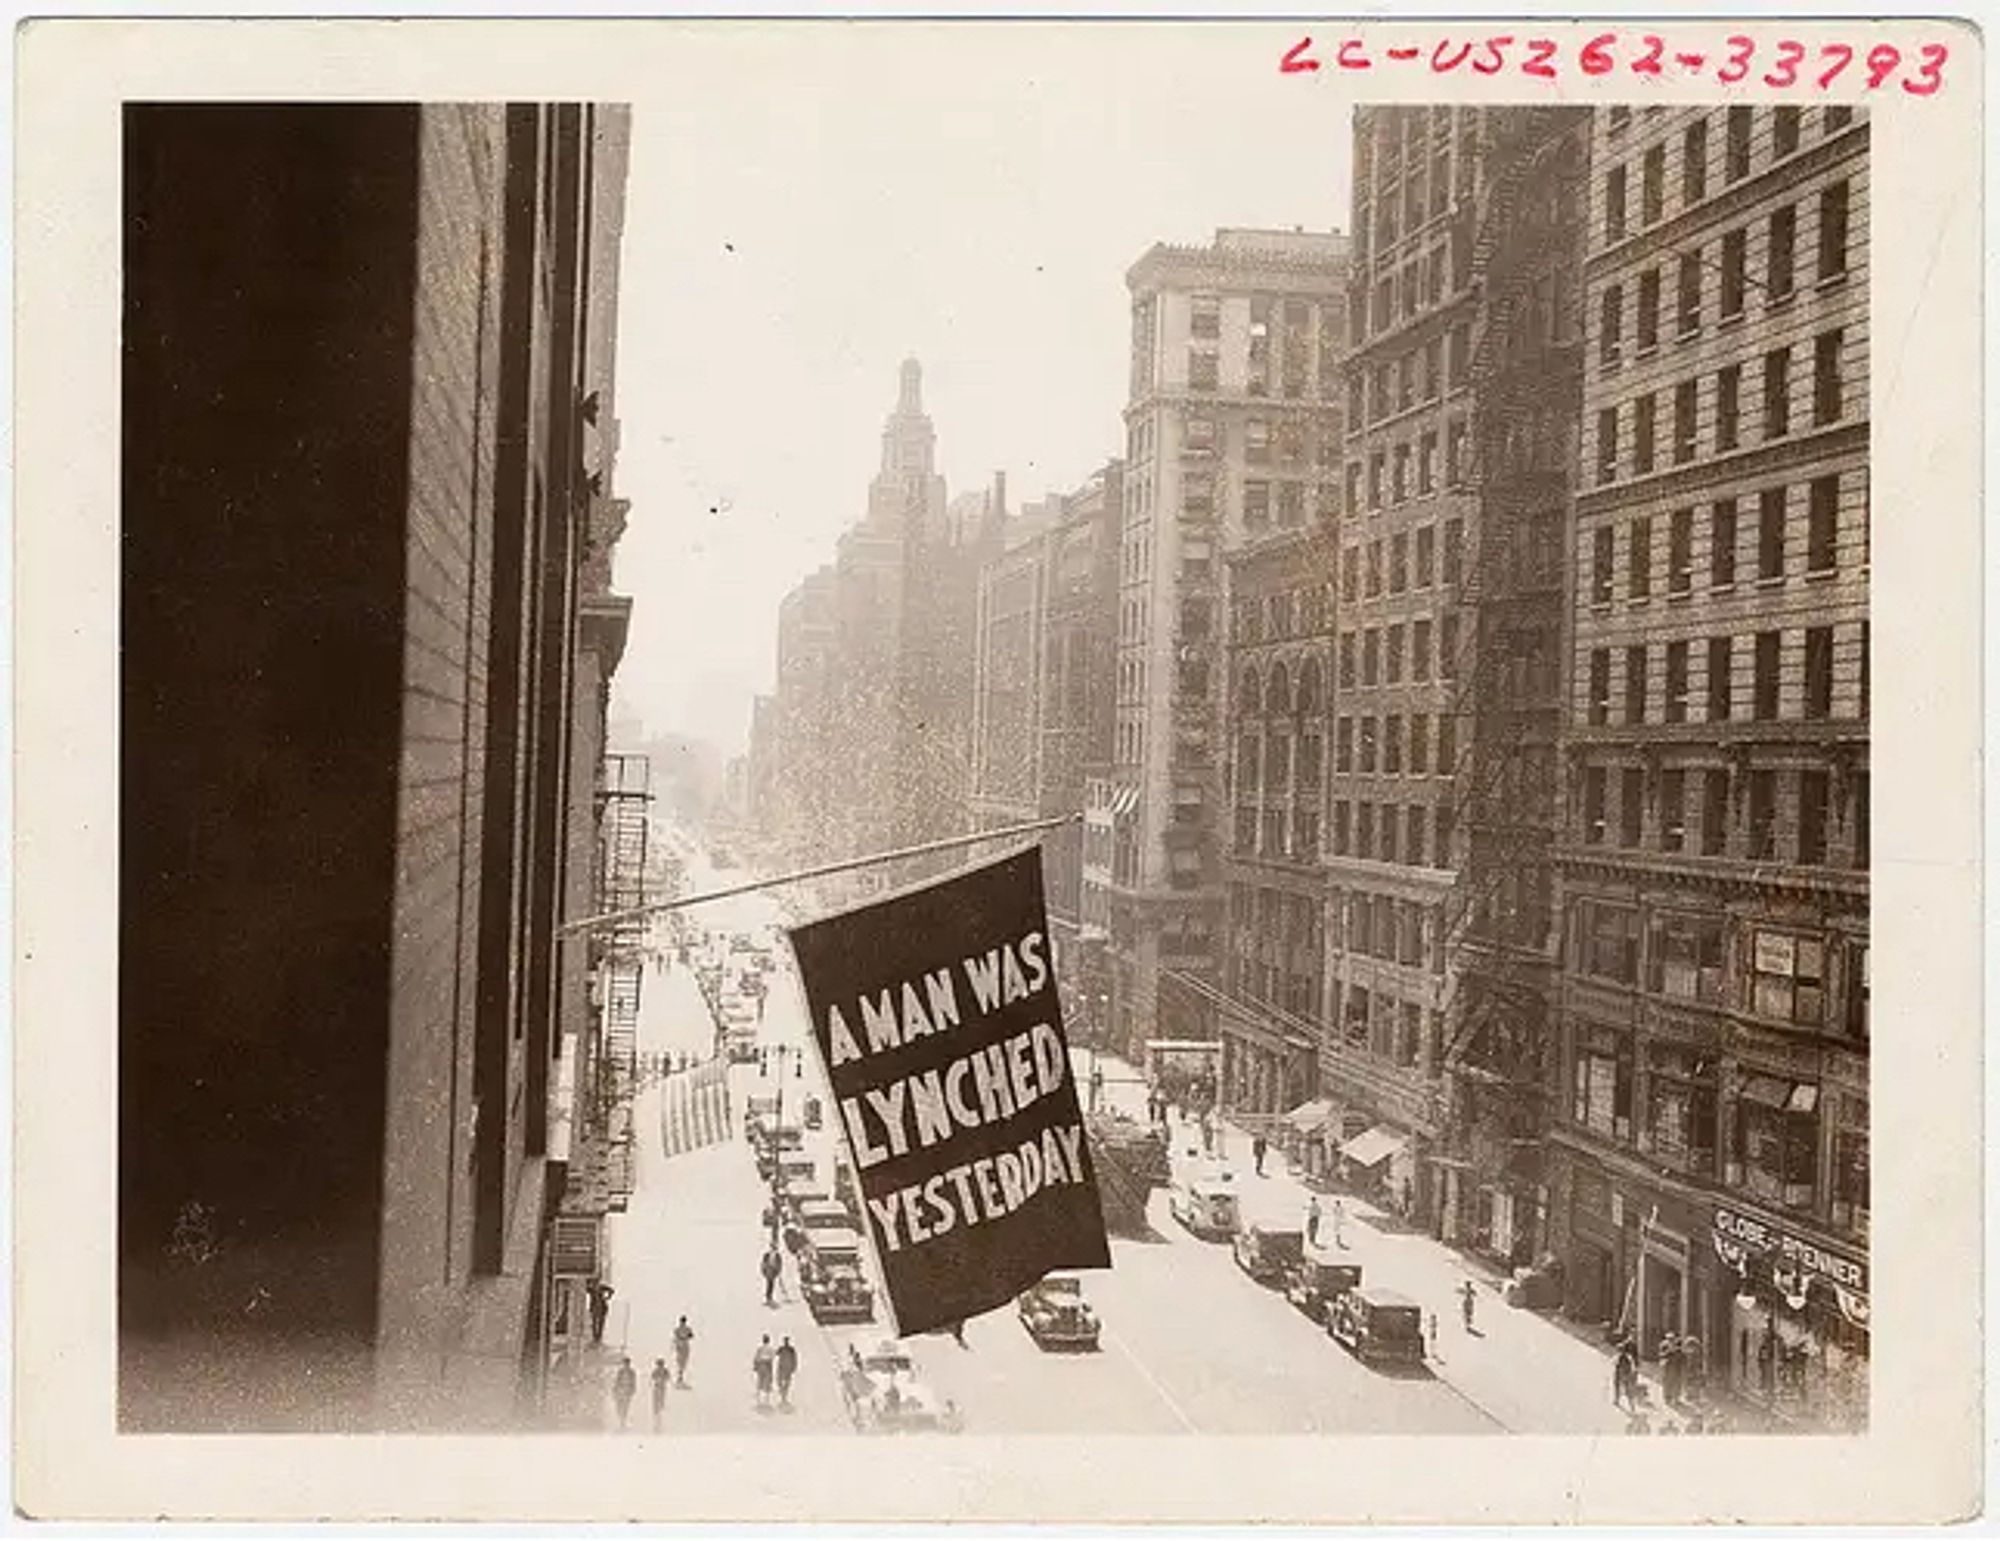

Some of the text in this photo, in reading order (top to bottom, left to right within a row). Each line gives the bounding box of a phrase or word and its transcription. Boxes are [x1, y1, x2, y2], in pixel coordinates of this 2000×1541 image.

[829, 931, 1047, 1067] A MAN WAS
[841, 1023, 1066, 1169] LYNCHED
[867, 1124, 1084, 1252] YESTERDAY
